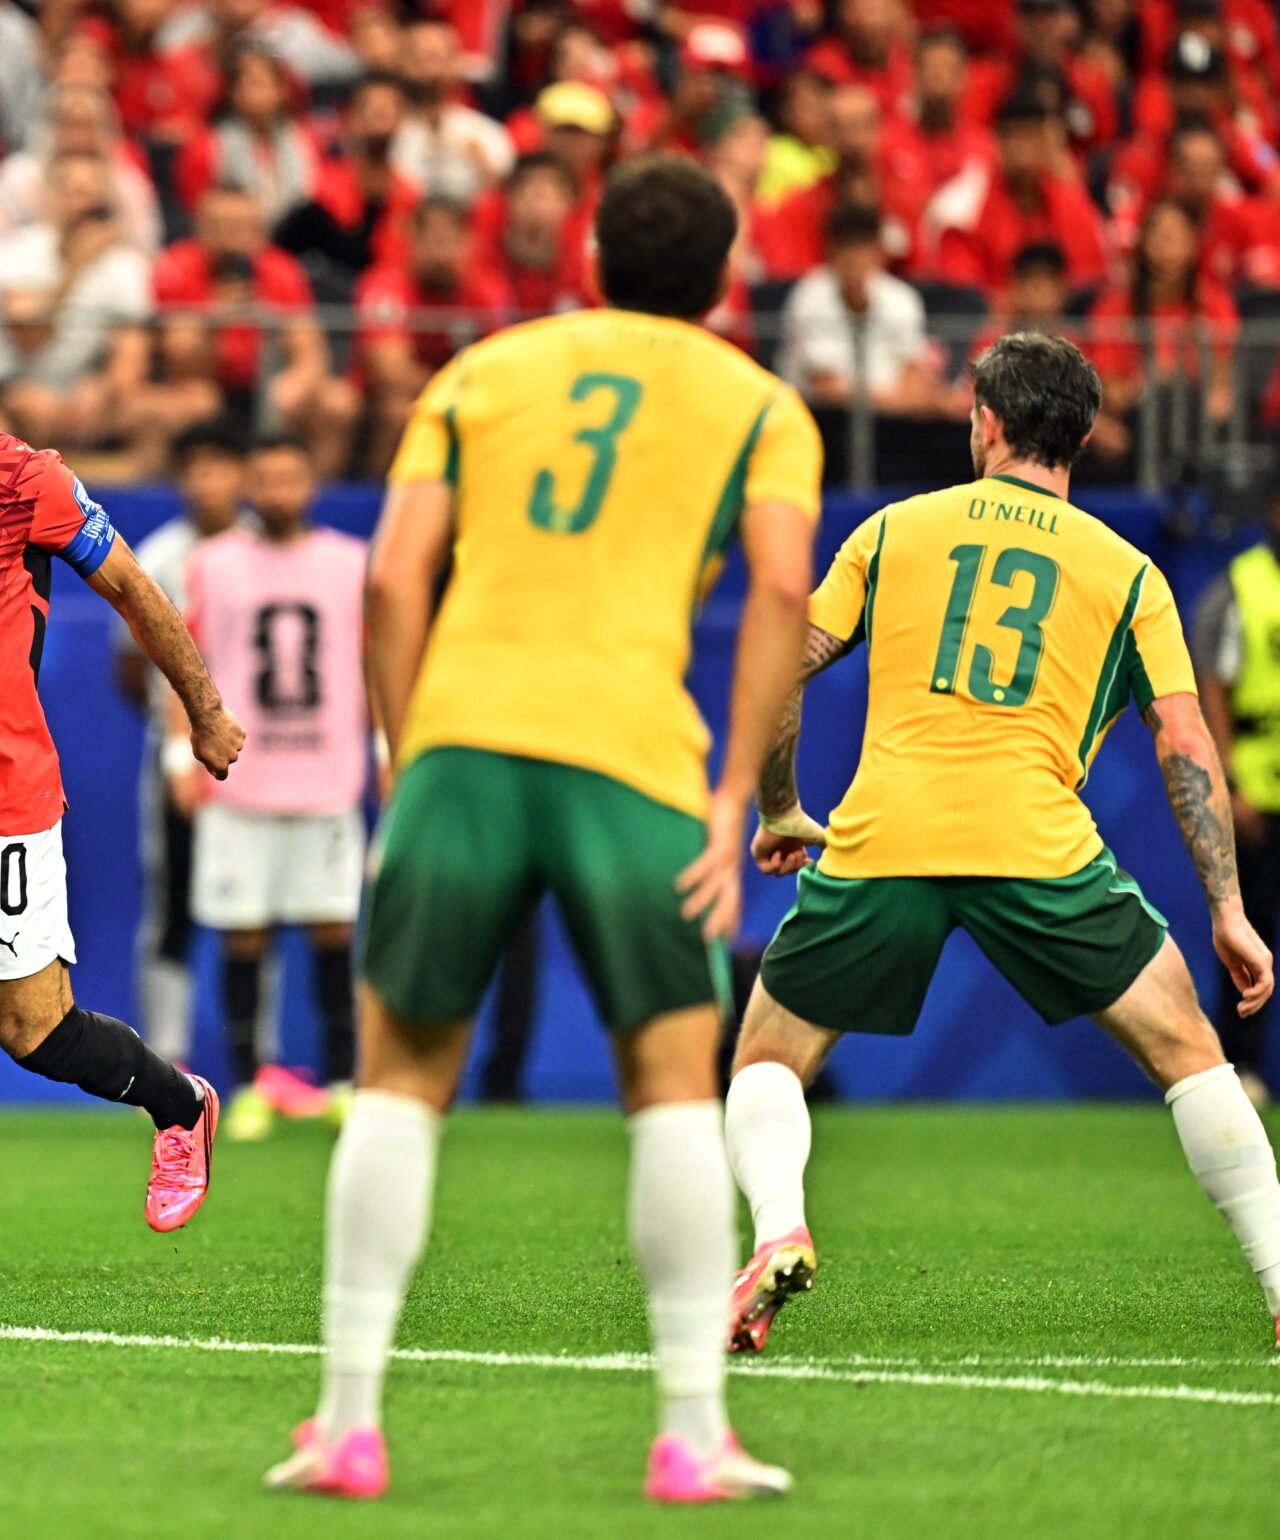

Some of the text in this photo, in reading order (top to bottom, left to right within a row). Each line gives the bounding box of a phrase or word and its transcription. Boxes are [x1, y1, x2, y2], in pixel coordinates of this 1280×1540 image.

[527, 372, 644, 536] 3
[968, 498, 1059, 536] O'NEILL
[930, 543, 1062, 708] 13
